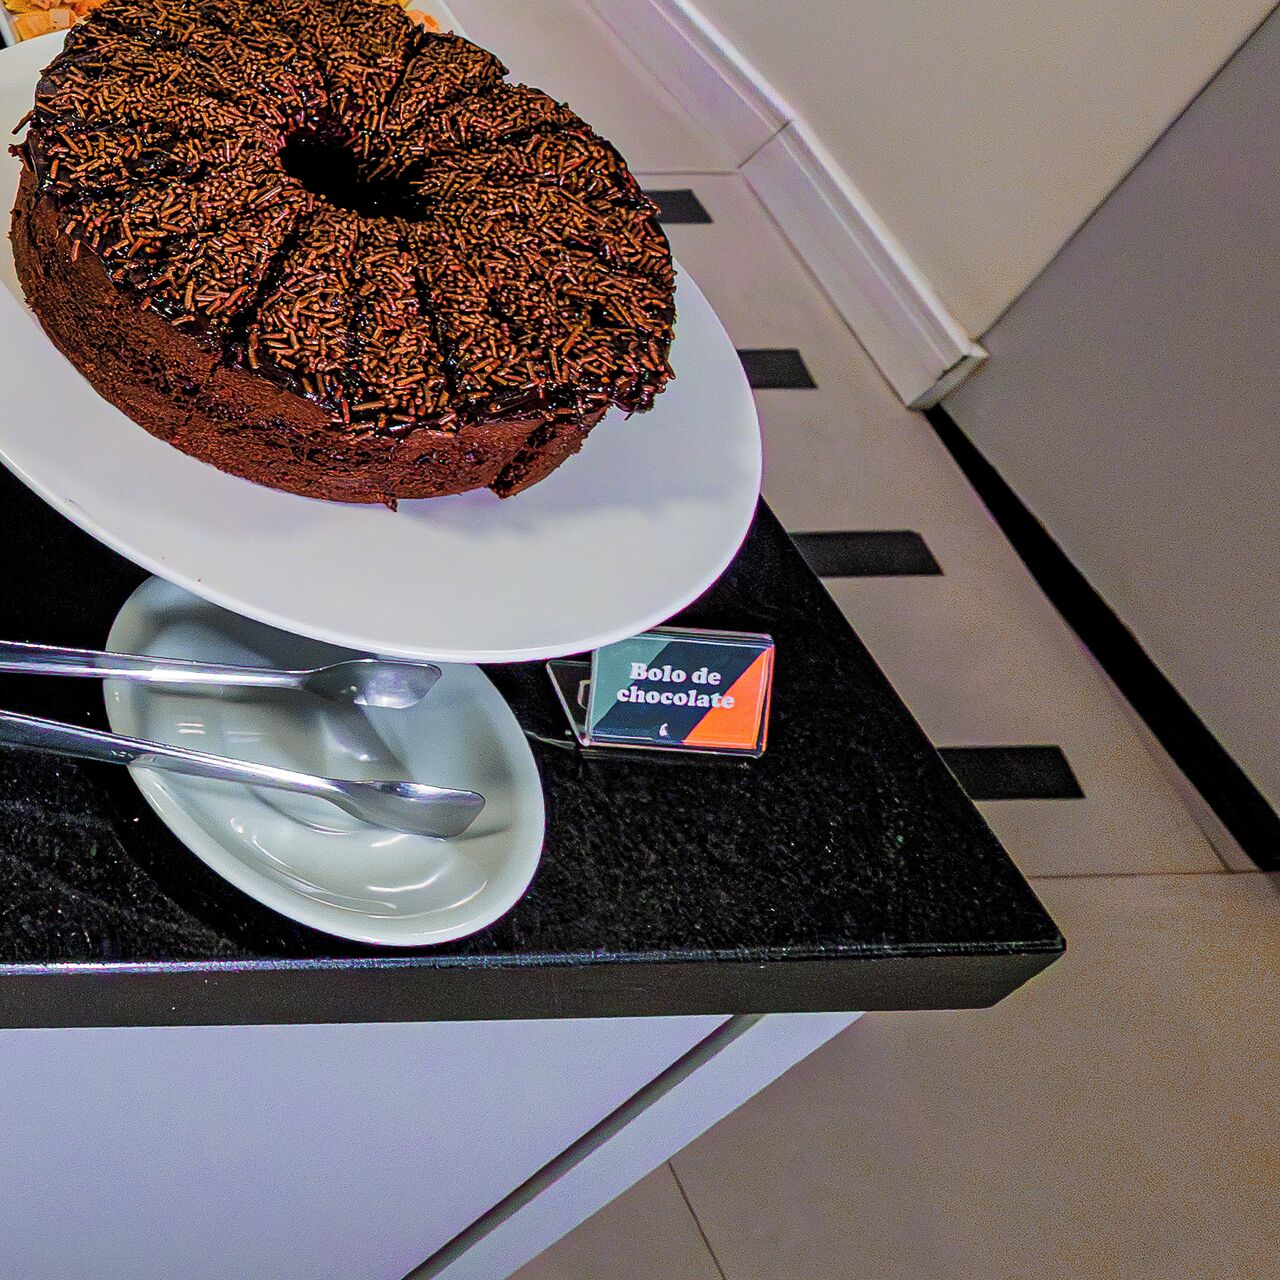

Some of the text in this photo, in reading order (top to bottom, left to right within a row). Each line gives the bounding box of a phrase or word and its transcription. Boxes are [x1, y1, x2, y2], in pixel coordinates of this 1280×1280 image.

[629, 662, 722, 686] Bolo de
[616, 685, 736, 709] chocolate
